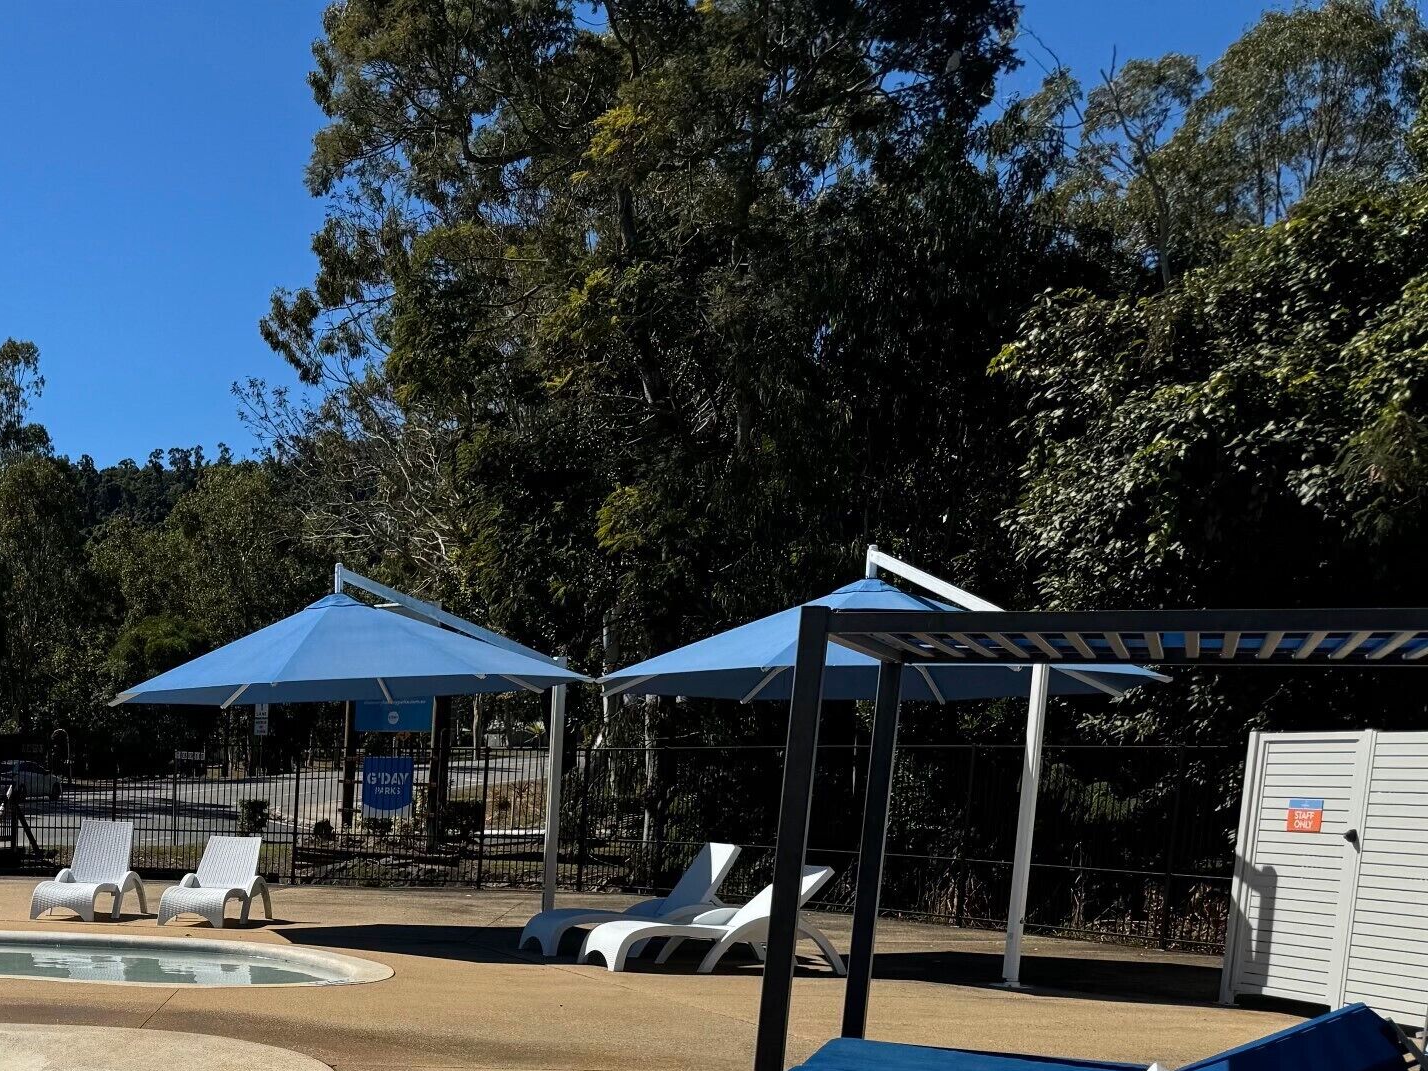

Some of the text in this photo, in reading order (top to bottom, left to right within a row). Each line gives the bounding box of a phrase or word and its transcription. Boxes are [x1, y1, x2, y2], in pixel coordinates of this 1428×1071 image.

[366, 772, 409, 785] G'DAY
[374, 786, 401, 795] PARKS
[1294, 811, 1315, 820] STAFF
[1294, 820, 1313, 828] ONLY
